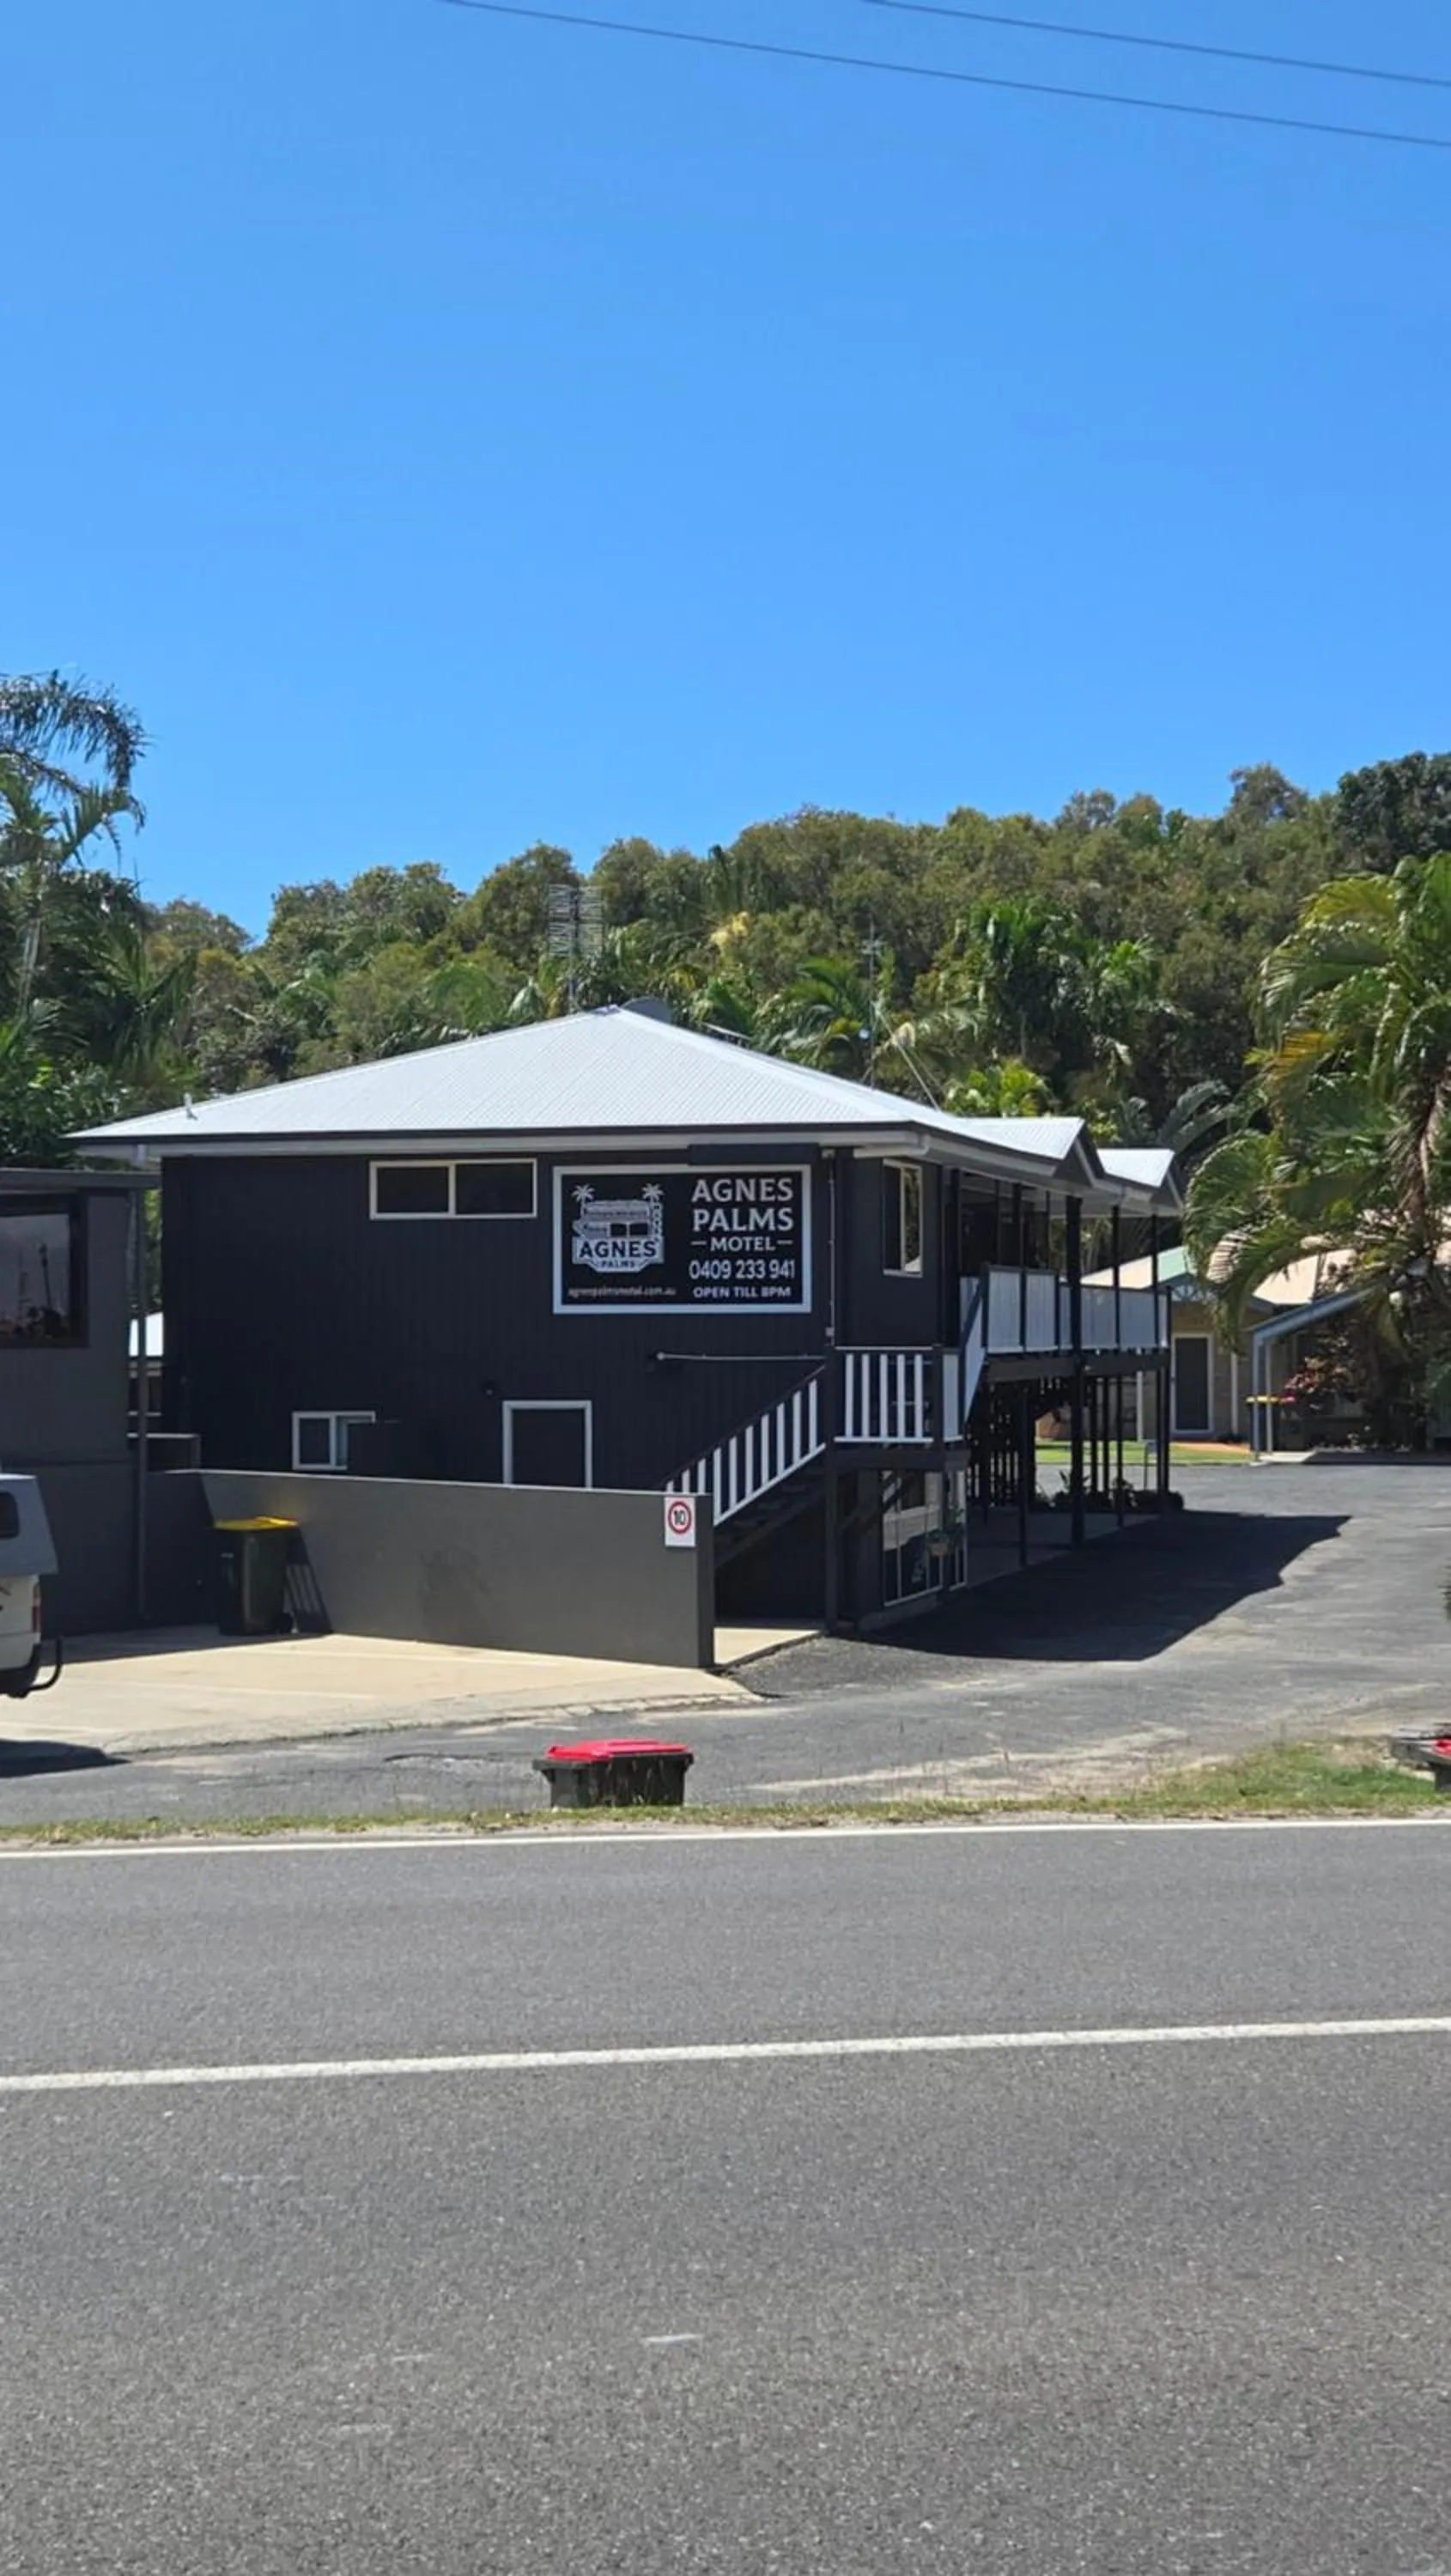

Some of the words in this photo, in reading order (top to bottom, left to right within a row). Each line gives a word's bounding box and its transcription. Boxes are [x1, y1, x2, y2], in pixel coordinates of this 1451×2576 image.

[692, 1177, 793, 1202] AGNES
[693, 1207, 794, 1232] PALMS
[580, 1241, 657, 1258] AGNES
[710, 1236, 776, 1251] MOTEL
[601, 1260, 635, 1268] PALMS
[689, 1260, 732, 1279] 0409
[735, 1260, 766, 1279] 233
[768, 1259, 795, 1279] 941
[693, 1286, 730, 1298] OPEN
[733, 1286, 758, 1297] TILL
[762, 1286, 792, 1297] 8PM
[674, 1510, 686, 1526] 10
